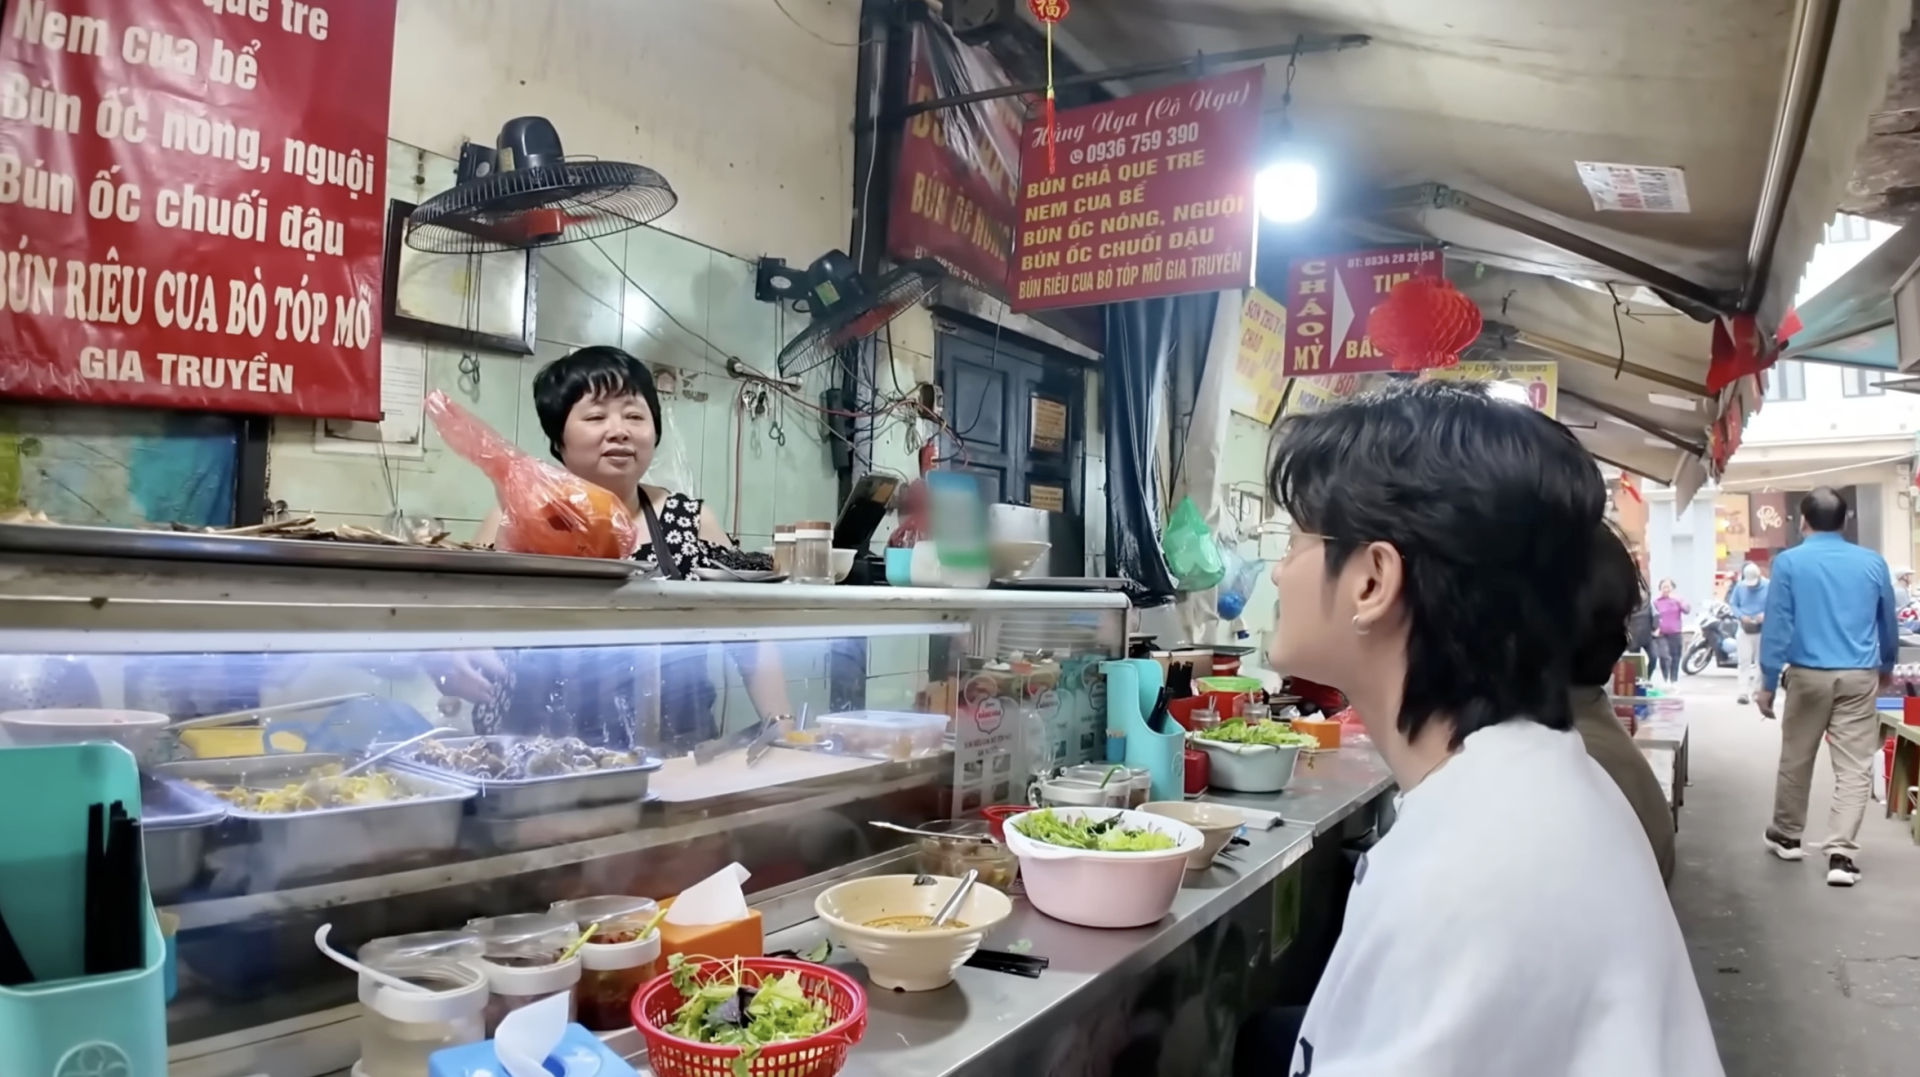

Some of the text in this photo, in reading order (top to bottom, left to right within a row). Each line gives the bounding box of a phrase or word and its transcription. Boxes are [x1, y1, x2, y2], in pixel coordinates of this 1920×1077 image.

[12, 0, 262, 91] Nem cua bể
[281, 0, 329, 41] tre
[2, 72, 374, 200] Bún ốc nóng, nguội
[1086, 122, 1199, 164] 0936 759 390
[1092, 111, 1137, 134] Nga
[1026, 149, 1205, 199] BÚN CHẢ QUE TRE
[0, 153, 344, 262] Bún ốc chuối đậu
[1023, 194, 1244, 247] BÚN ỐC NÓNG, NGUỘI
[1025, 180, 1147, 223] NEM CUA BỂ
[1019, 276, 1041, 300] BÚN
[1043, 270, 1069, 296] RIÊU
[1071, 273, 1094, 293] CUA
[1096, 263, 1113, 290] BÒ
[1116, 263, 1139, 287] TÓP
[1166, 258, 1186, 280] GIA
[1191, 245, 1242, 276] TRUYỀN
[1021, 227, 1215, 271] BÚN ỐC CHUỐI ĐẬU
[66, 246, 147, 325] RIÊU
[154, 269, 218, 333] CUA
[226, 266, 267, 338] BÒ
[274, 274, 328, 345] TÓP
[332, 284, 372, 350] MỠ
[79, 346, 293, 395] GIA TRUYỀN
